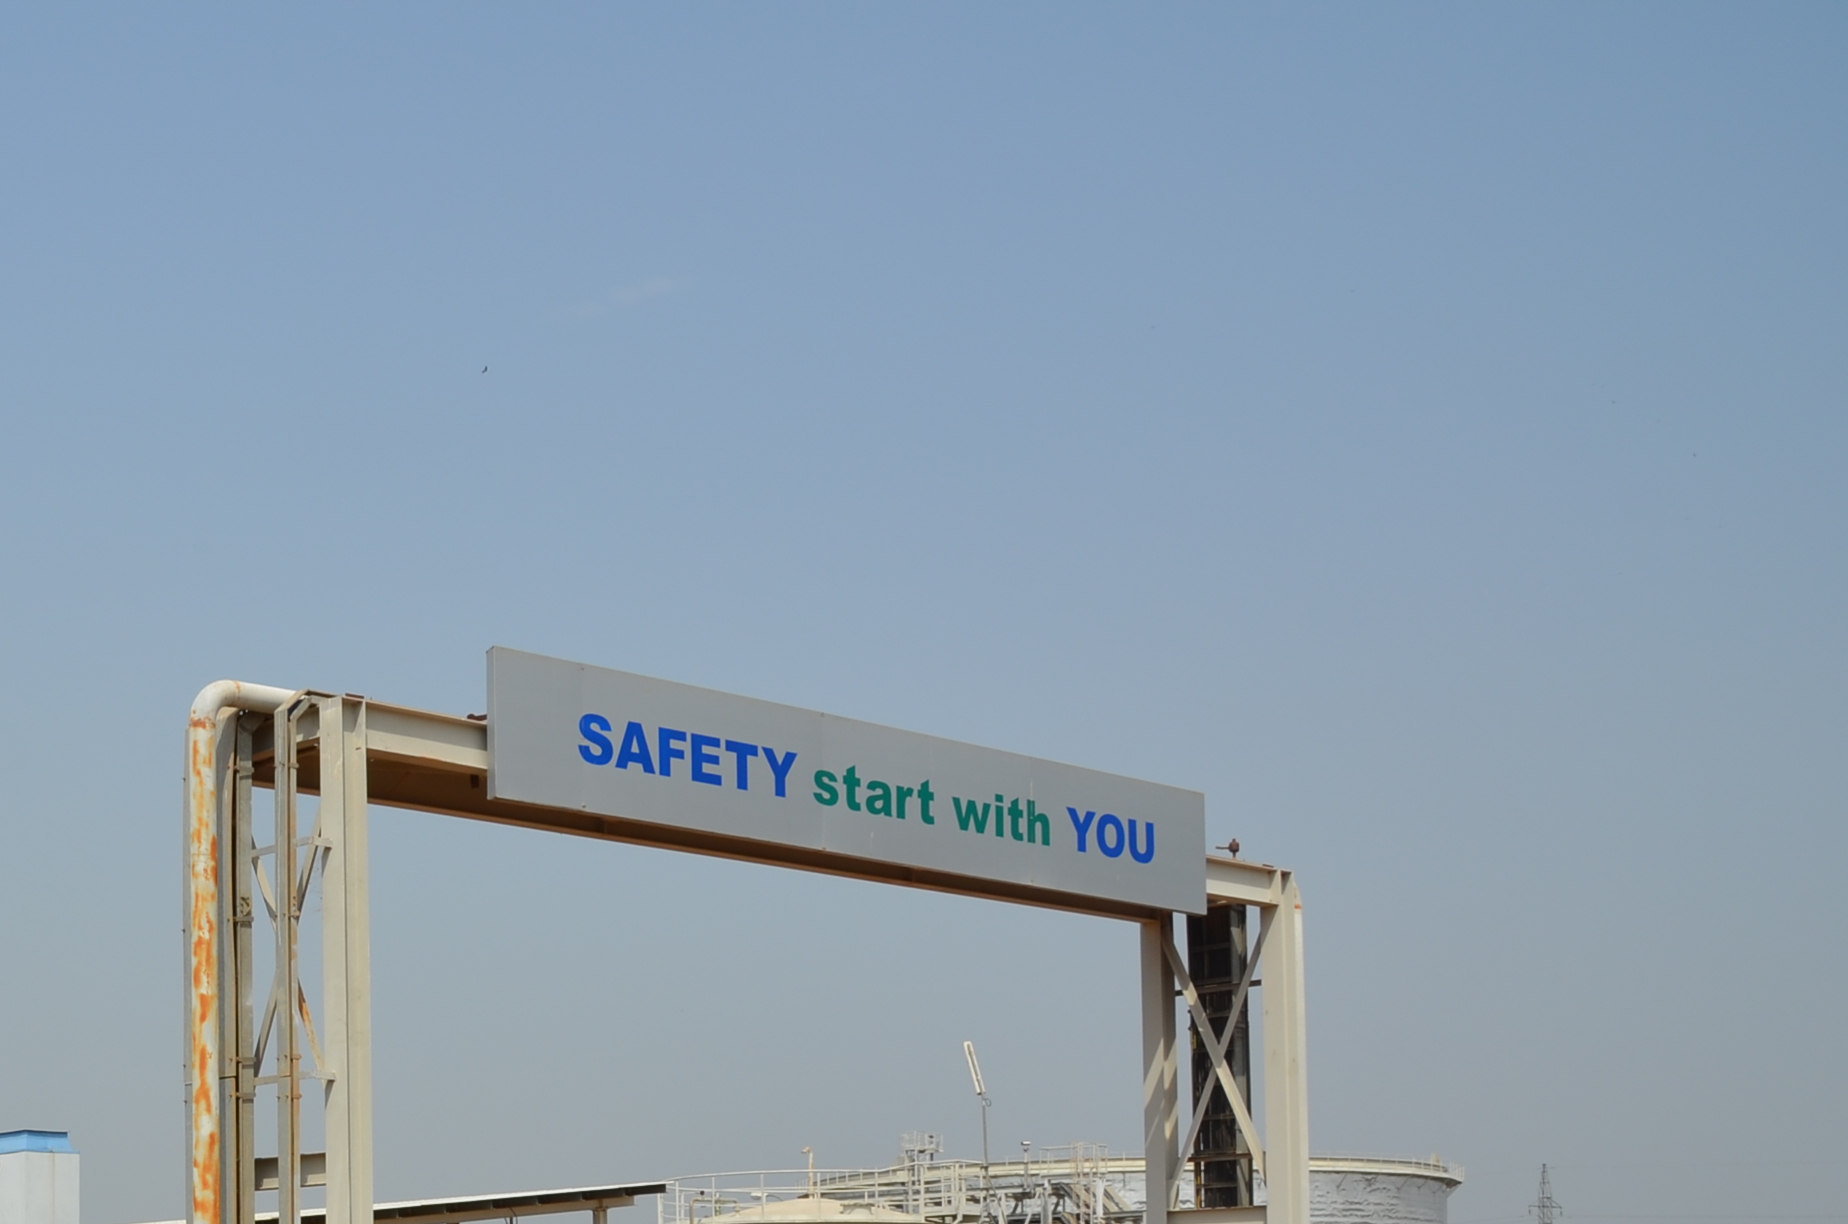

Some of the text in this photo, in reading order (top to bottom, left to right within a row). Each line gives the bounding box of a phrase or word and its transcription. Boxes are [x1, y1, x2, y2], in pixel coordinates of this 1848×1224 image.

[578, 713, 1155, 864] SAFETY start with YOU
